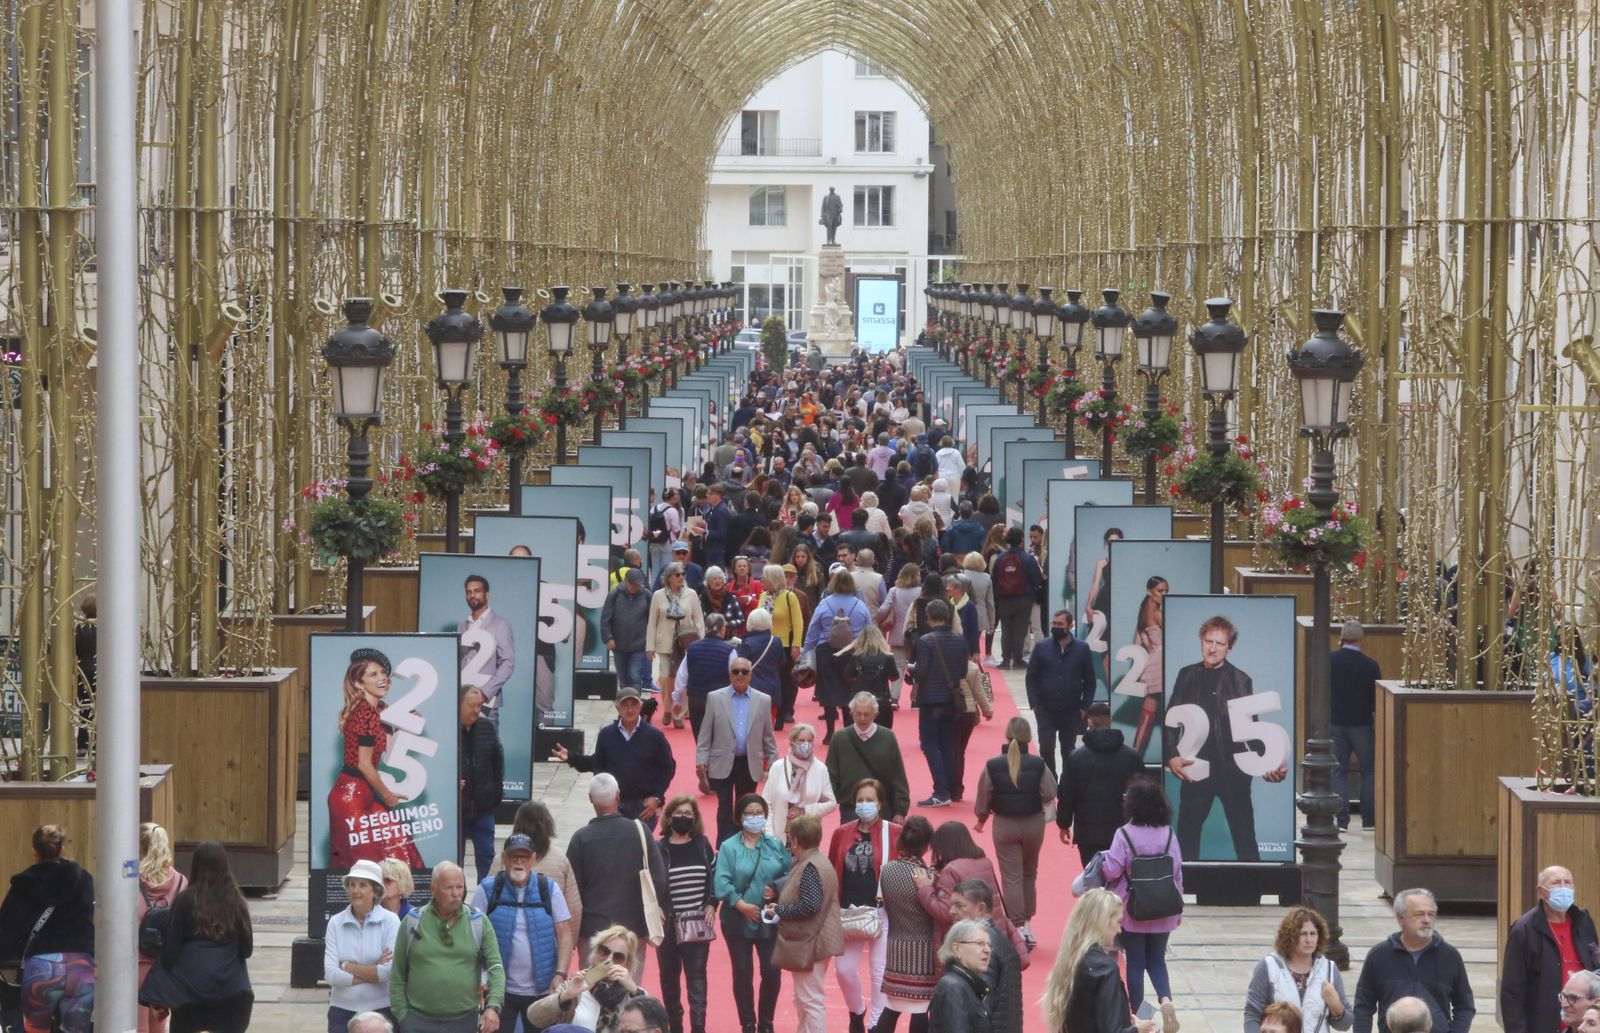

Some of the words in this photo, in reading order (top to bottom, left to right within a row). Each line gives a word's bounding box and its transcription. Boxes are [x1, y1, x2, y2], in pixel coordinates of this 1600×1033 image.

[862, 316, 896, 325] smassa
[1113, 644, 1149, 697] 2
[345, 817, 356, 832] Y
[359, 803, 439, 829] SEGUIMOS
[348, 830, 370, 846] DE
[372, 818, 444, 842] ESTRENO
